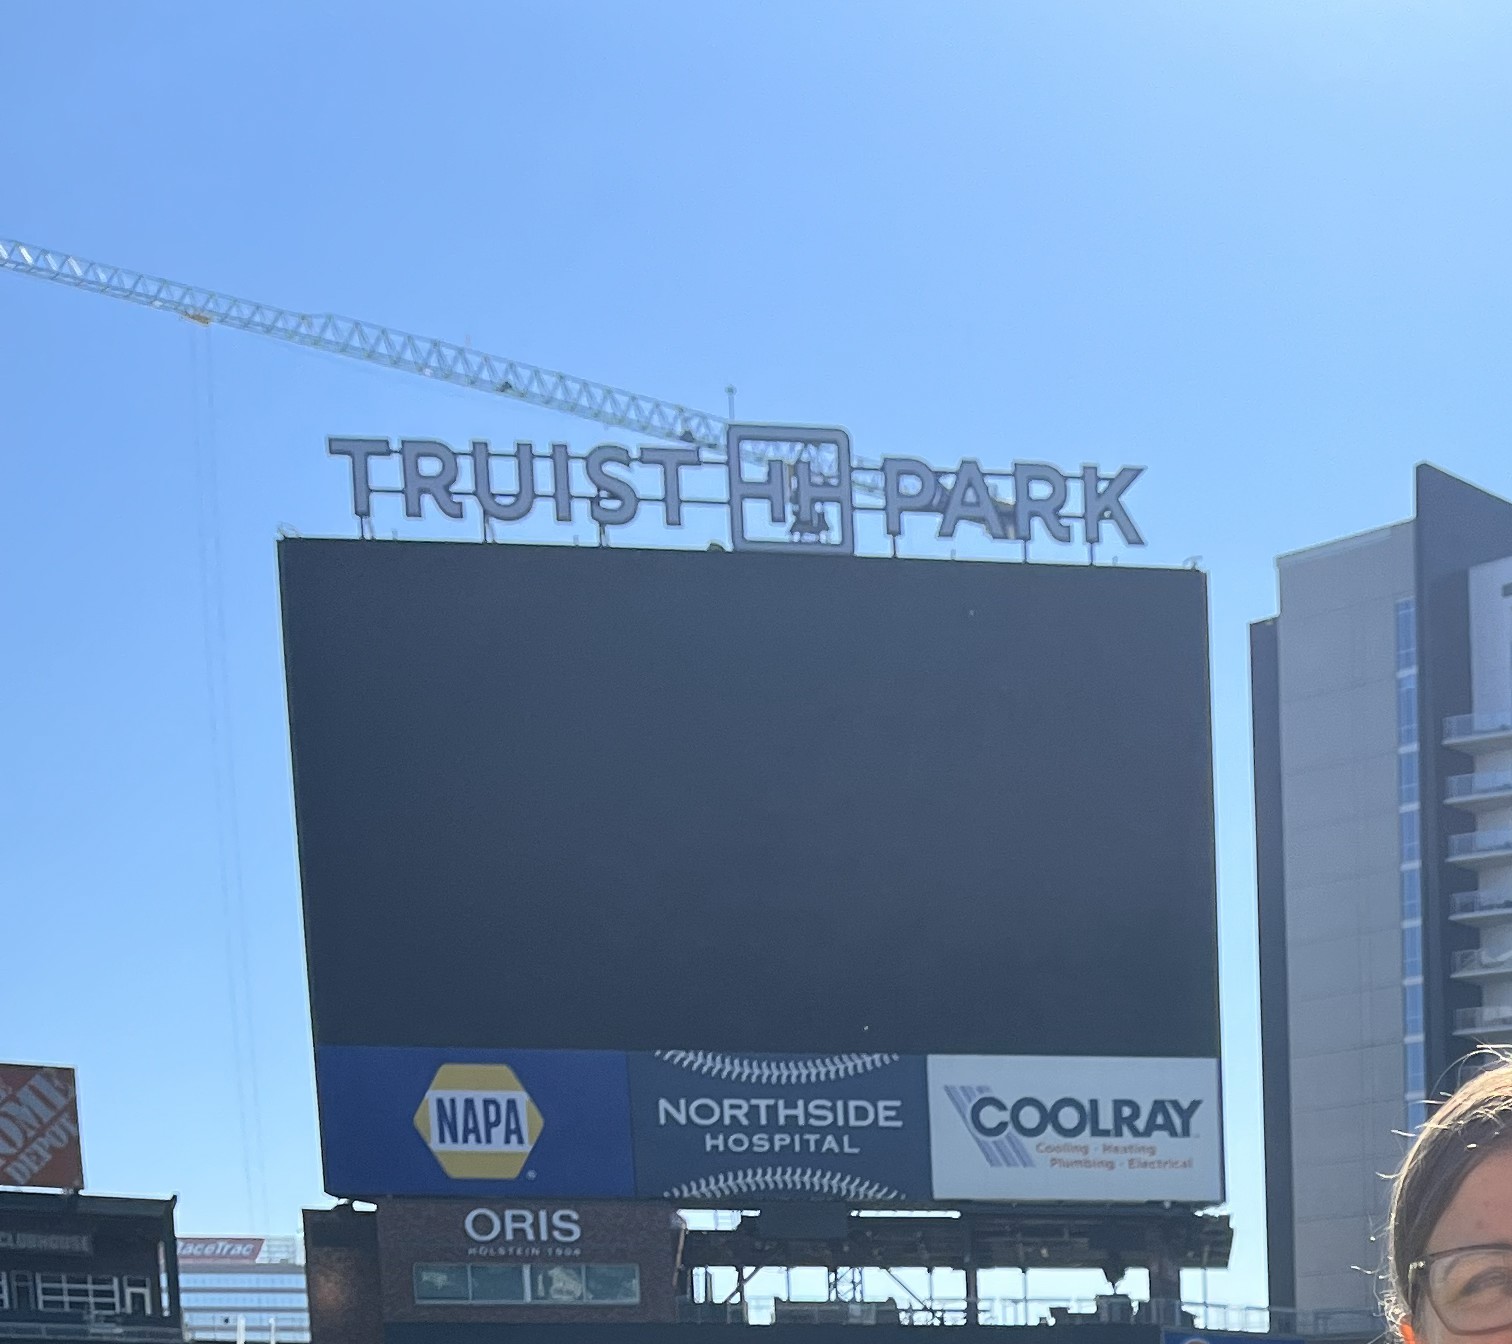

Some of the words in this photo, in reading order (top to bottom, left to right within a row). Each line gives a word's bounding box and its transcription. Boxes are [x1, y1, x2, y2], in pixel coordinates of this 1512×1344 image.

[328, 438, 699, 526] TRUIST
[883, 458, 1145, 544] PARK
[436, 1097, 525, 1145] NAPA
[658, 1098, 904, 1128] NORTHSIDE
[971, 1096, 1204, 1138] COOLRAY
[704, 1132, 861, 1154] HOSPITAL
[1035, 1142, 1090, 1156] Cooling
[1102, 1142, 1157, 1157] Heating
[1050, 1157, 1116, 1171] Plumbing
[1128, 1157, 1193, 1170] Electrical
[464, 1208, 582, 1243] ORIS
